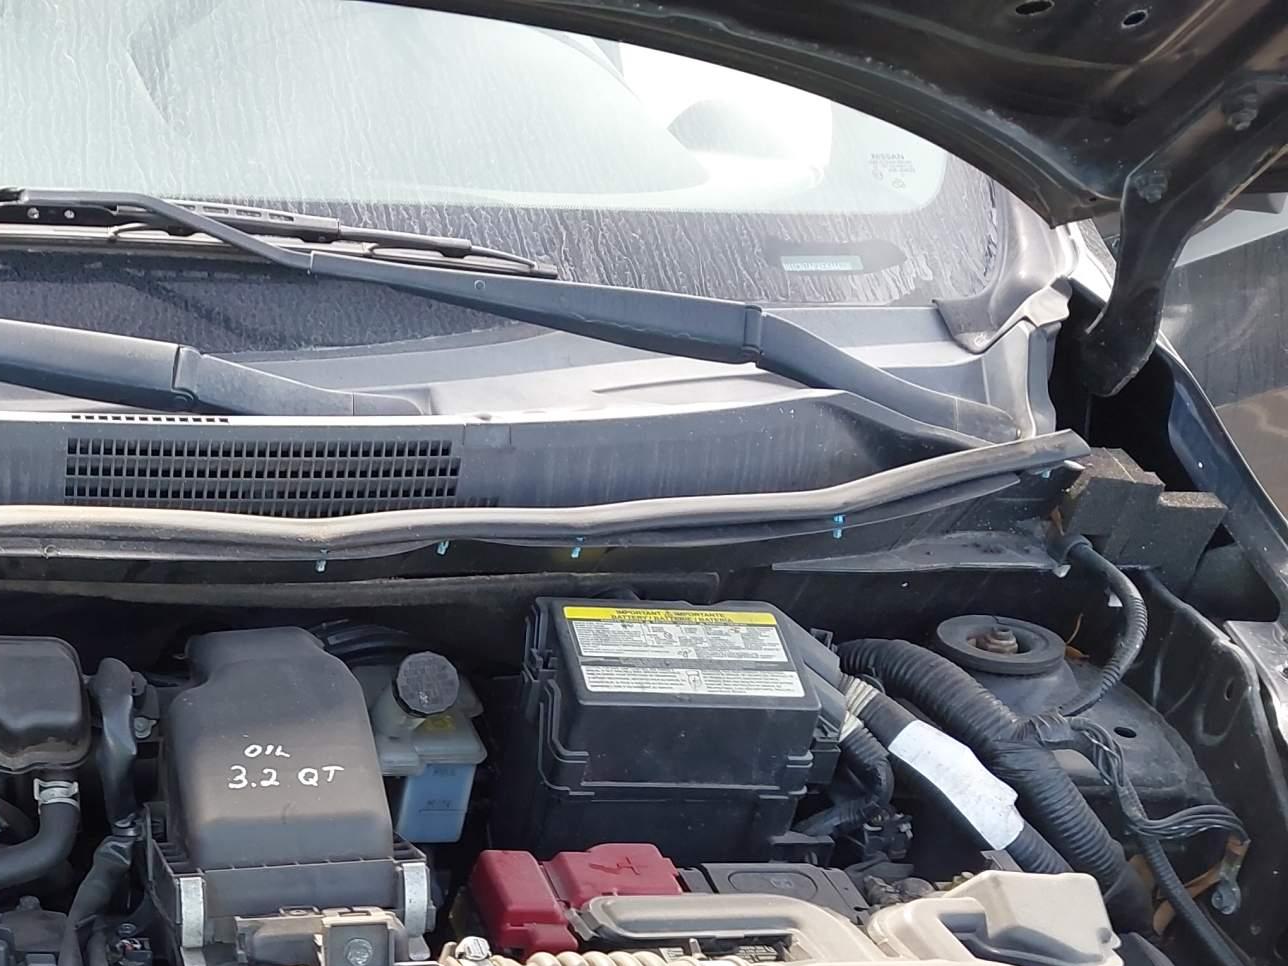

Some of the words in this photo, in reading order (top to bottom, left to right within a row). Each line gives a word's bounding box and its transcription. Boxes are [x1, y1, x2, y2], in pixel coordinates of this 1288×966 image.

[244, 744, 291, 758] OIL
[228, 765, 280, 789] 3.2
[297, 765, 345, 787] QT
